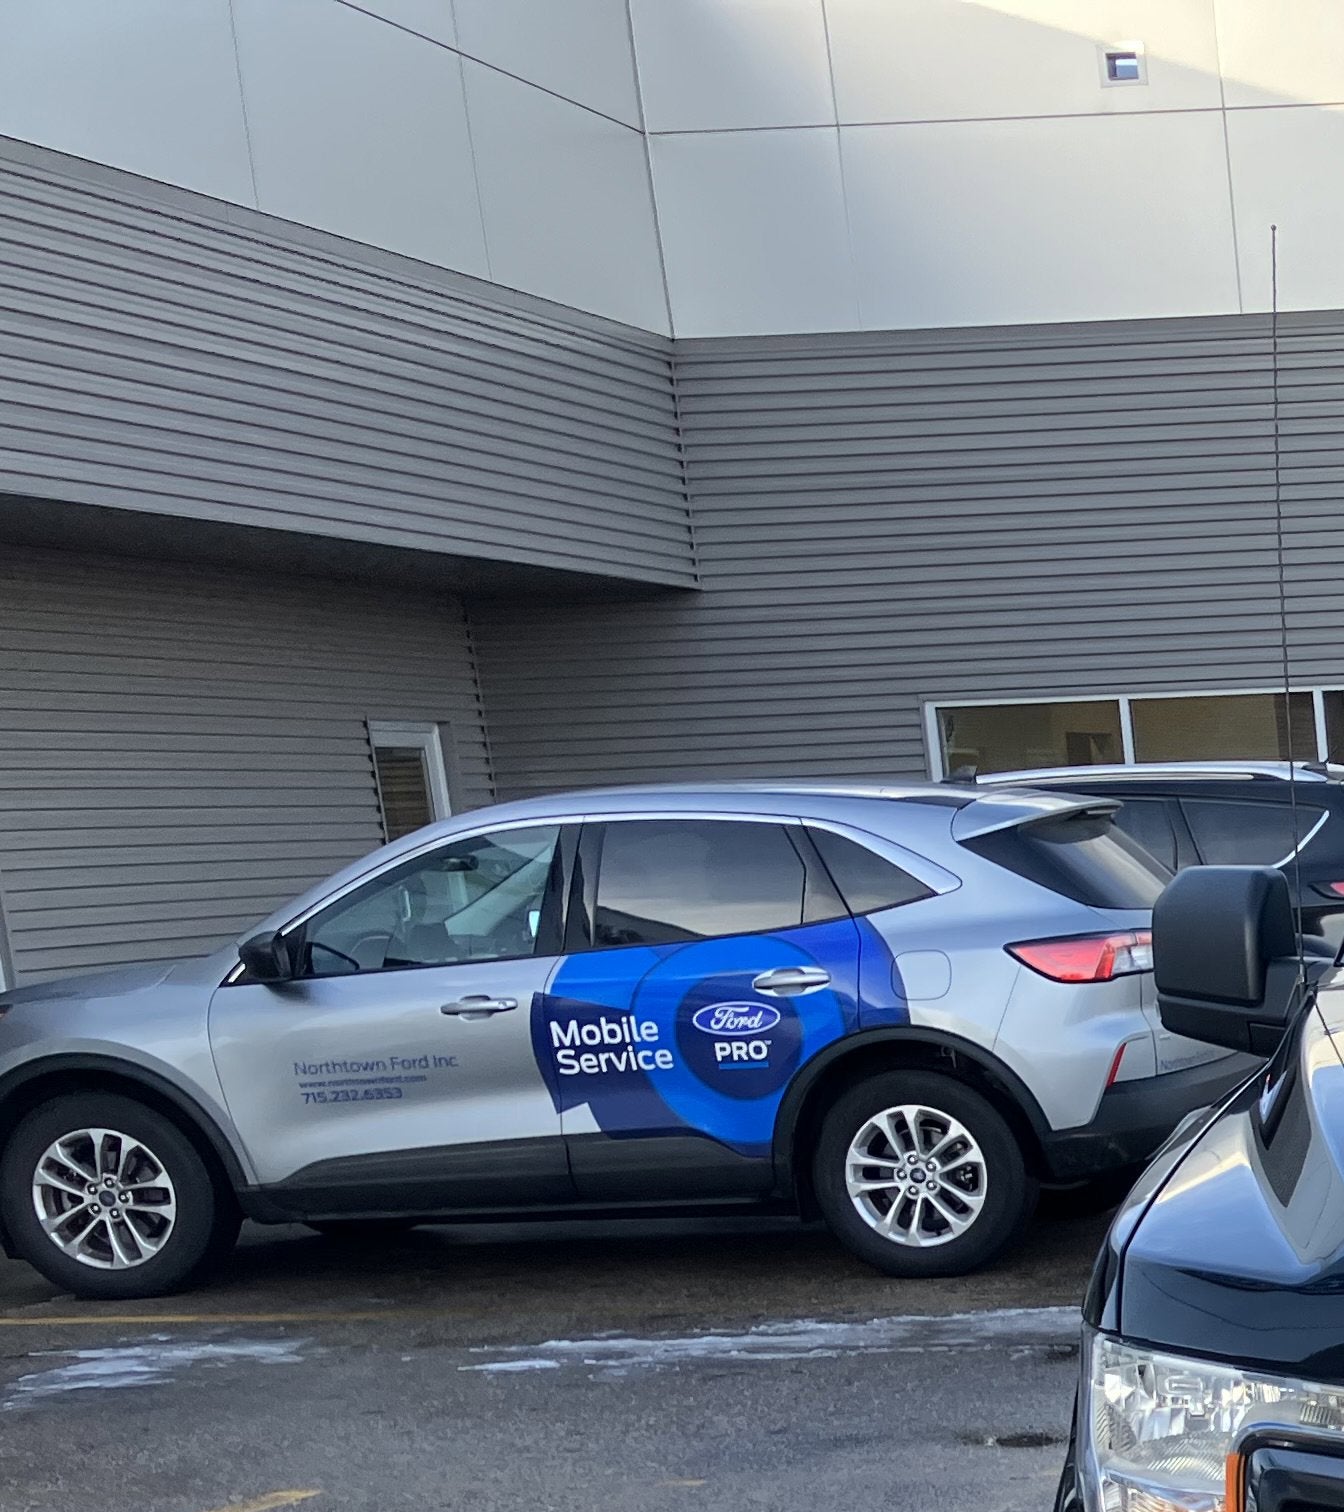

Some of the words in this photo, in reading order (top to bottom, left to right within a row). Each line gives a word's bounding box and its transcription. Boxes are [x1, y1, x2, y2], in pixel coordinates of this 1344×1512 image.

[549, 1015, 660, 1048] Mobile
[709, 1006, 763, 1031] Ford
[293, 1059, 388, 1076] Northtown
[389, 1055, 429, 1072] Ford
[555, 1045, 675, 1076] Service
